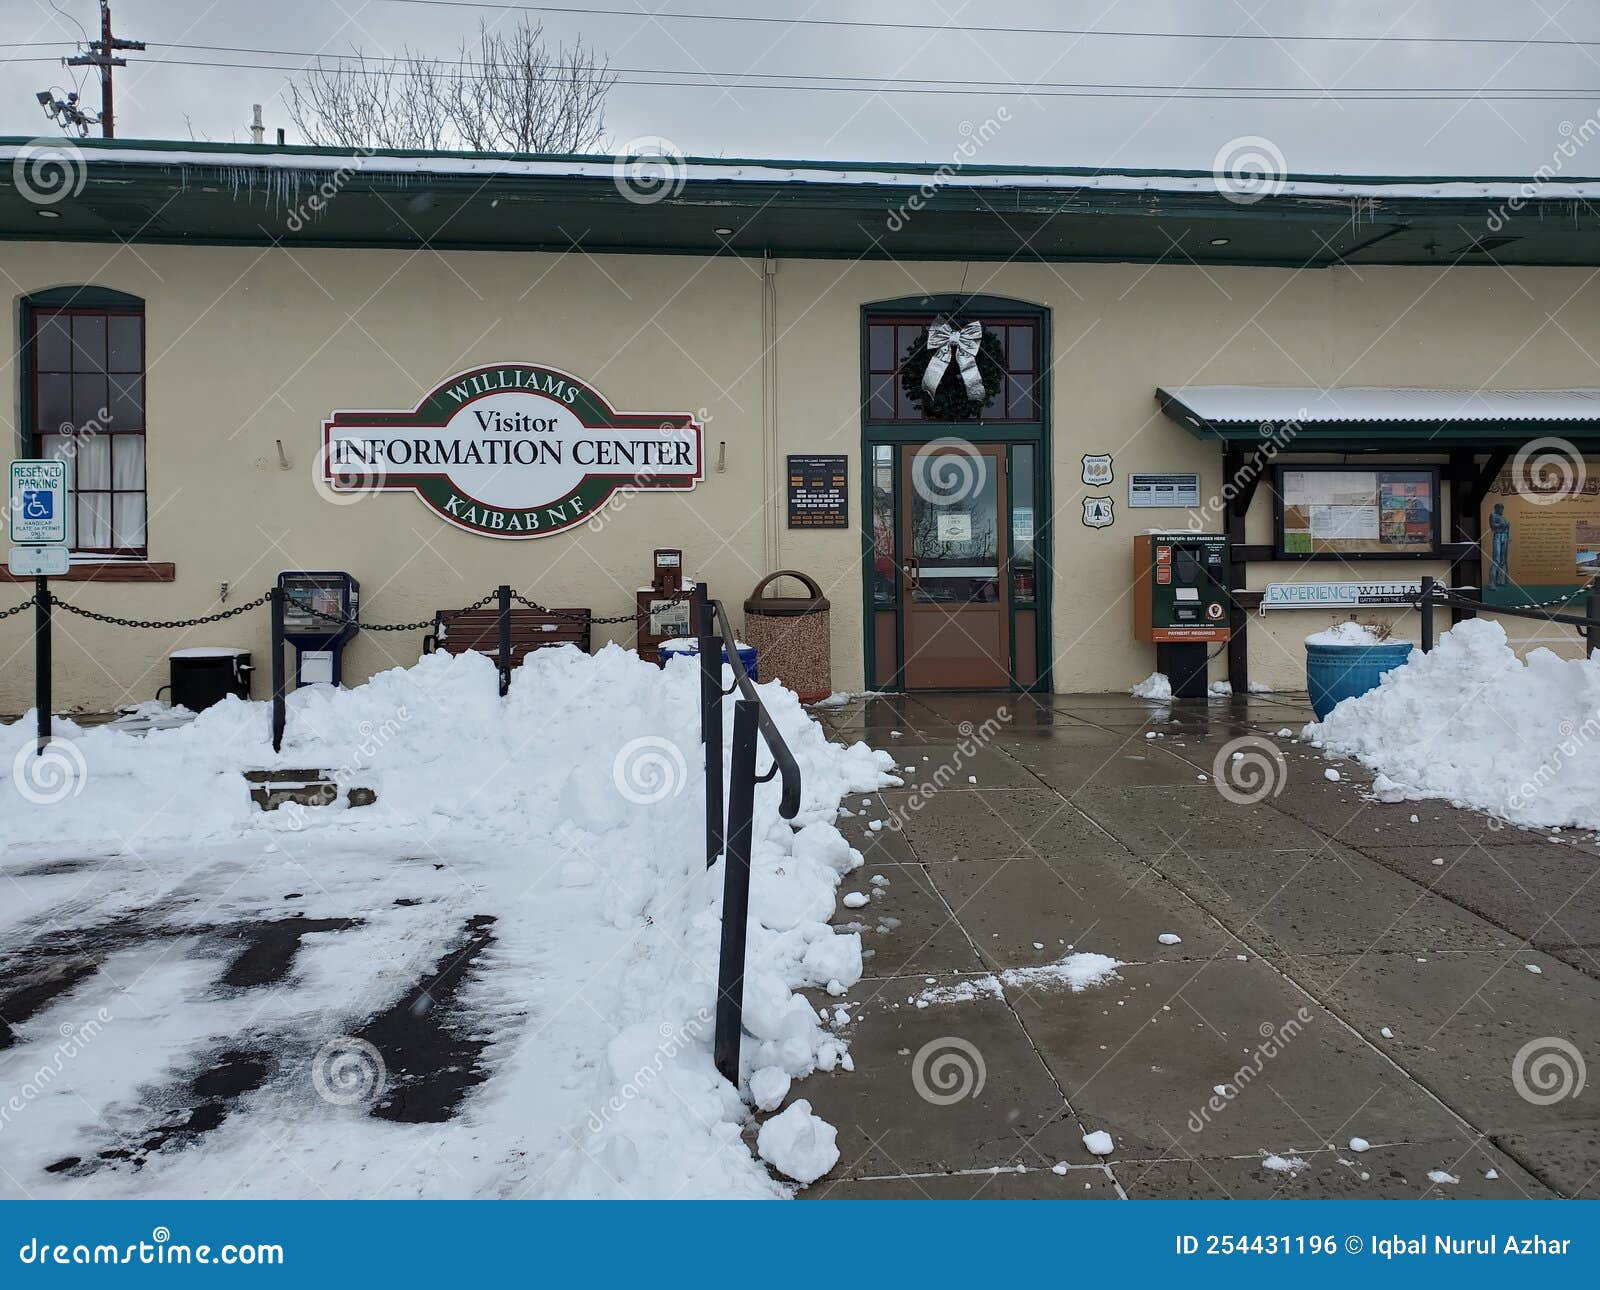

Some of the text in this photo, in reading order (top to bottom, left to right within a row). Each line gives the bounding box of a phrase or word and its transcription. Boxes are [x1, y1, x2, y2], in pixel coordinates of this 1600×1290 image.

[446, 369, 580, 404] WILLIAMS
[473, 410, 558, 433] Visitor
[333, 438, 694, 467] INFORMATION CENTER
[14, 467, 62, 478] RESERVED
[18, 479, 58, 489] PARKING
[443, 494, 586, 531] KAIBAB N F
[1270, 585, 1421, 601] EXPERIENCE WILLIA
